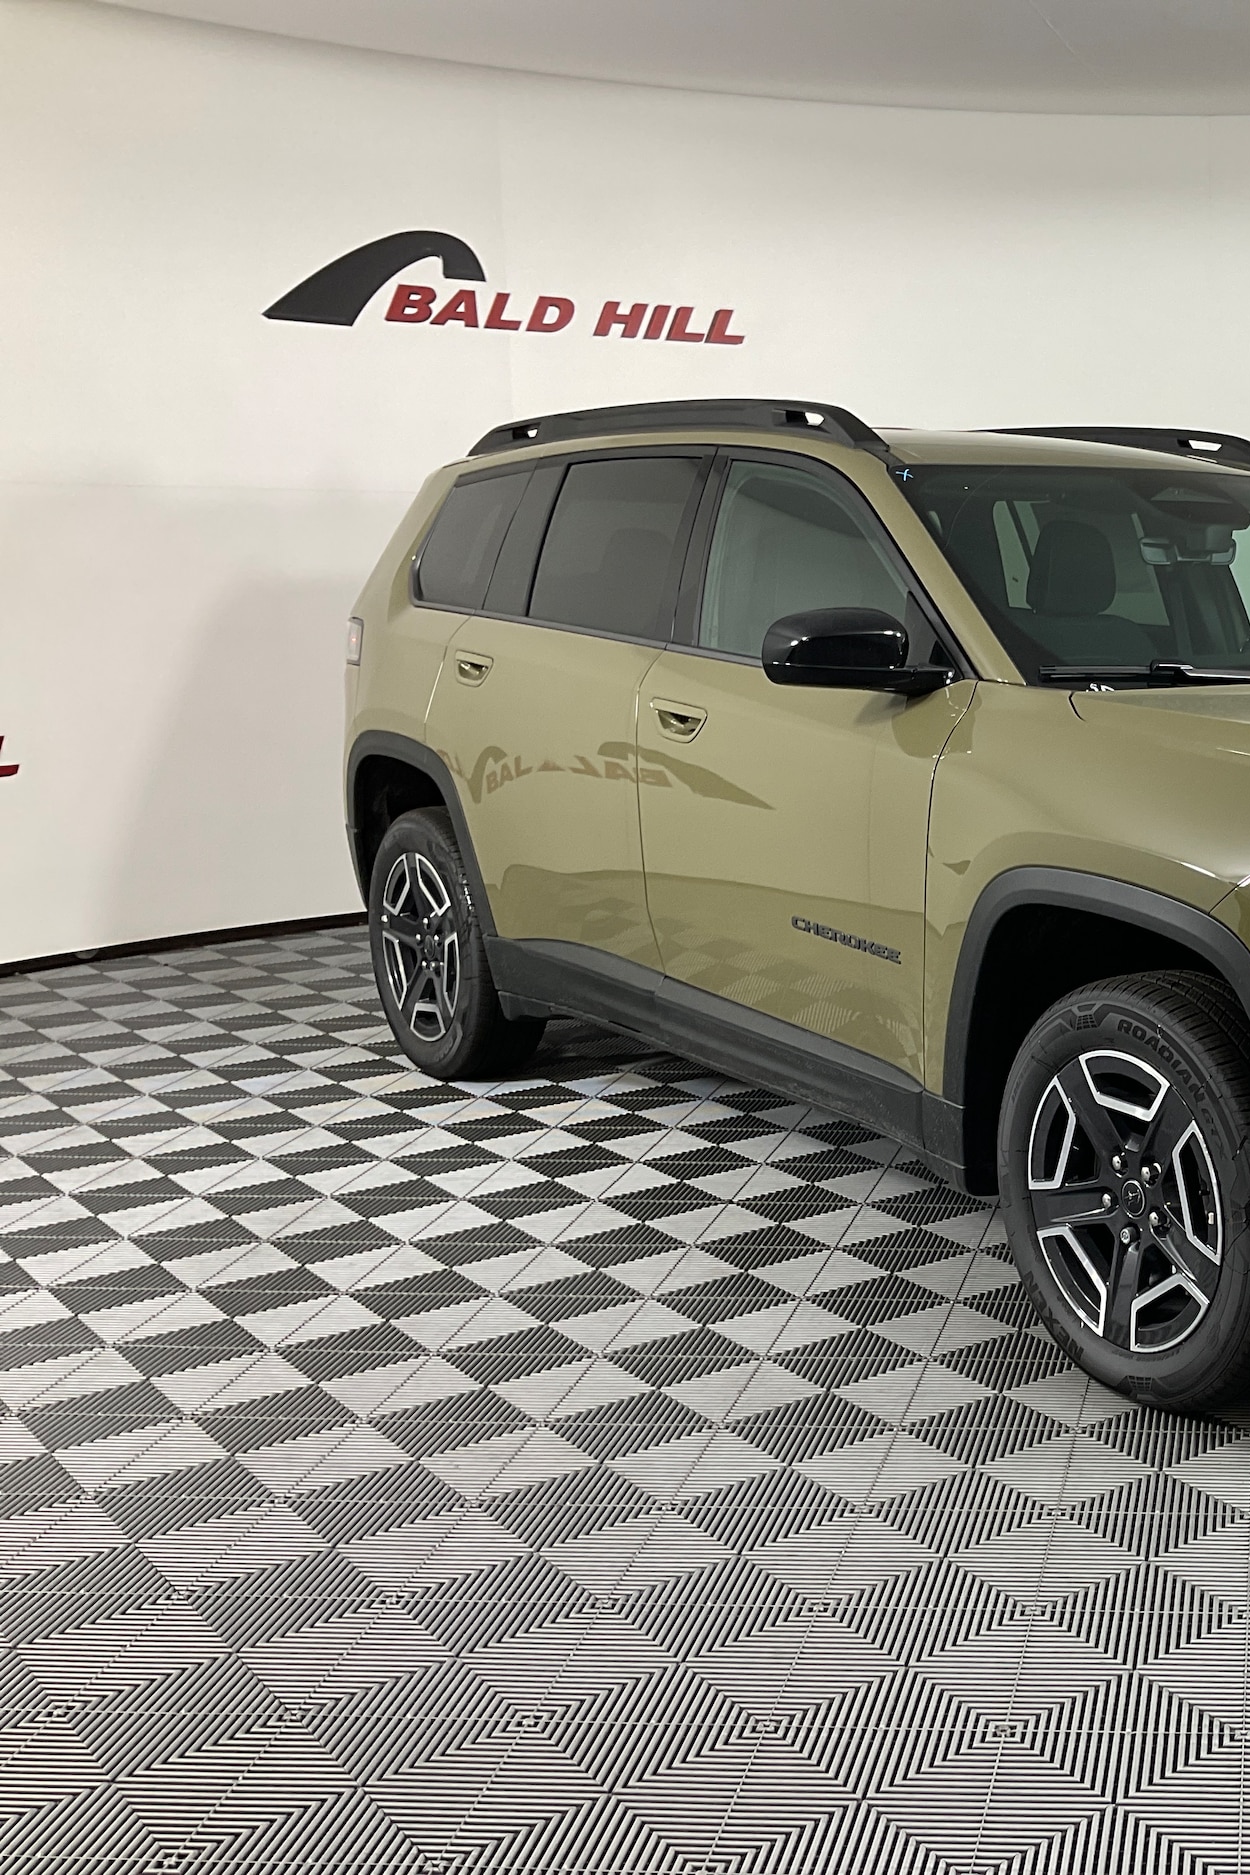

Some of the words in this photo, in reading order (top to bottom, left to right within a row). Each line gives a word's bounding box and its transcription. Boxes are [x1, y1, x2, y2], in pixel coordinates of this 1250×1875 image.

[384, 283, 575, 333] BALD
[592, 300, 746, 346] HILL
[486, 755, 550, 794] BAL
[791, 915, 902, 965] CHEROKEE
[1117, 1019, 1206, 1103] ROADIAN
[1022, 1270, 1085, 1361] NEXEN
